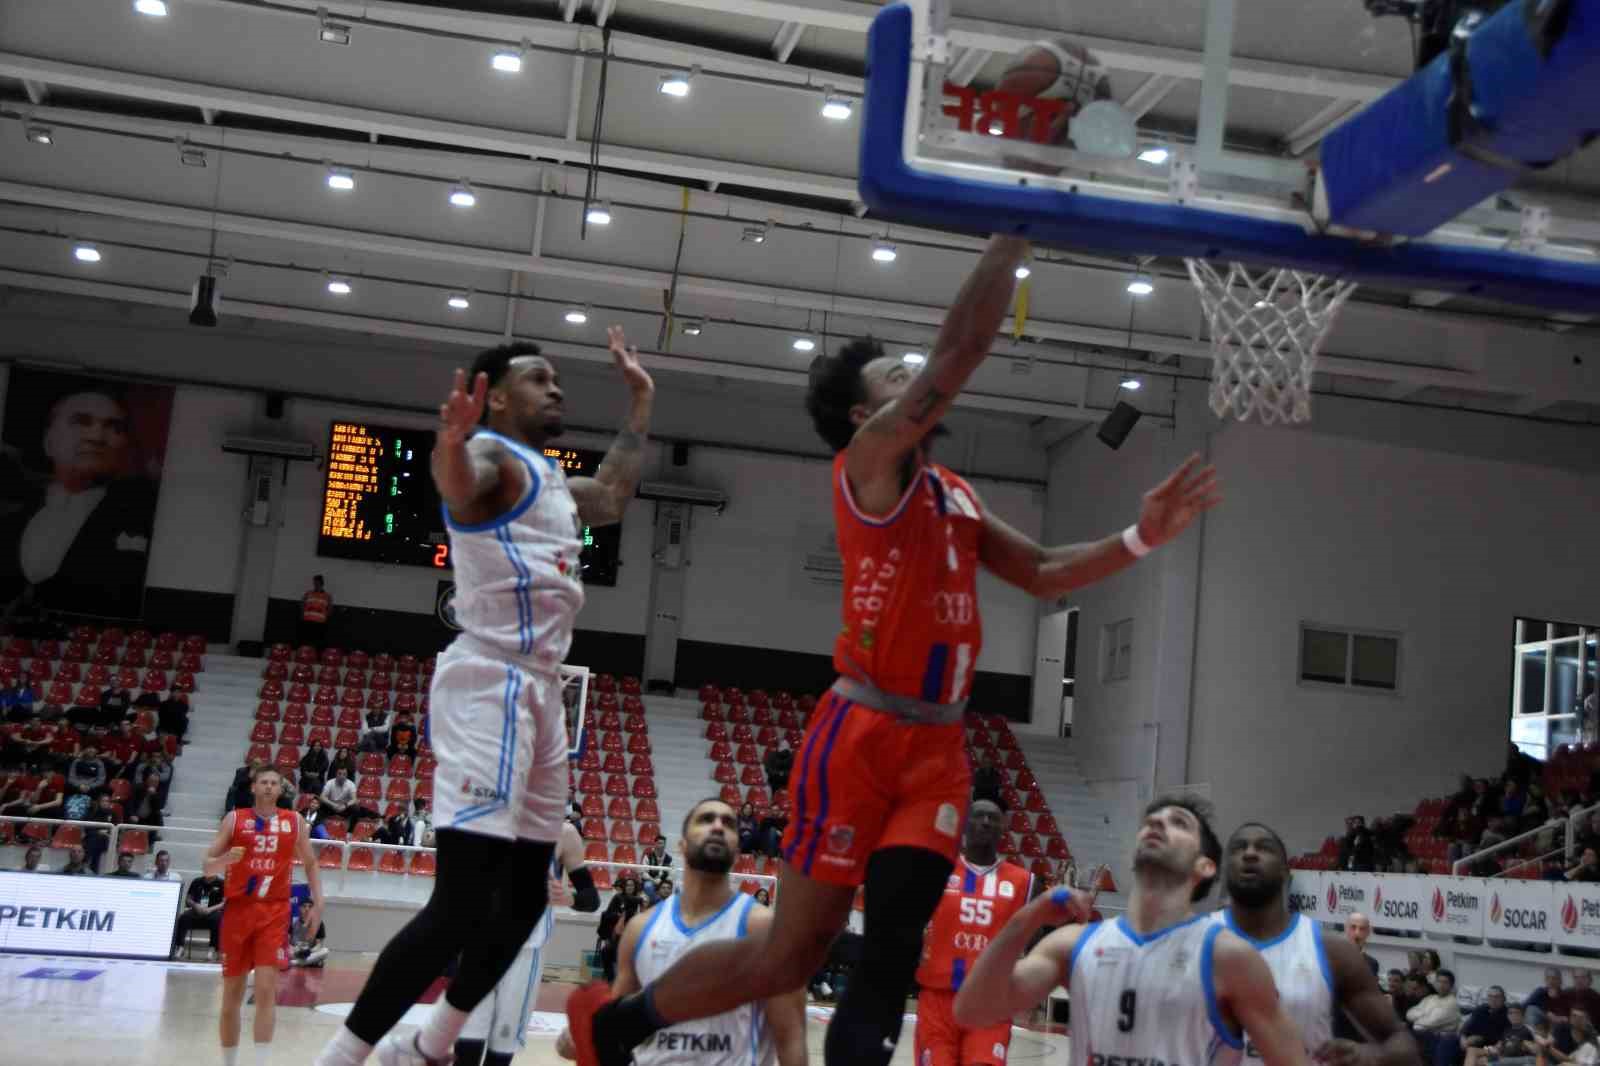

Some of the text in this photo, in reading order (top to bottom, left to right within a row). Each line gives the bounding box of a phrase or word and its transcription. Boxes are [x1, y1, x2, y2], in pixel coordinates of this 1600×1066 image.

[254, 834, 278, 853] 33
[960, 896, 993, 926] 55
[1384, 900, 1418, 918] SOCAR
[1504, 908, 1547, 930] SOCAR
[1116, 988, 1138, 1033] 9
